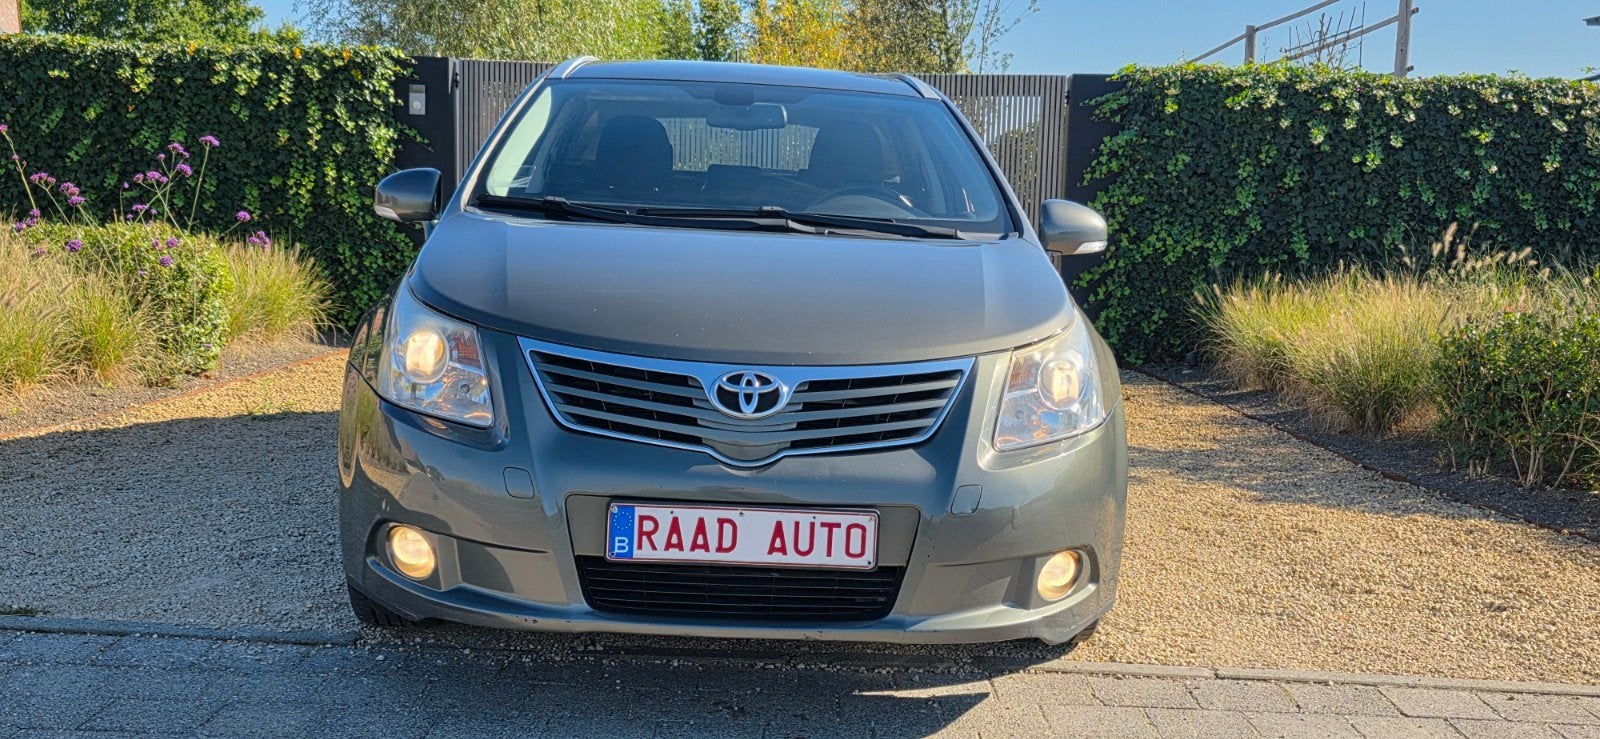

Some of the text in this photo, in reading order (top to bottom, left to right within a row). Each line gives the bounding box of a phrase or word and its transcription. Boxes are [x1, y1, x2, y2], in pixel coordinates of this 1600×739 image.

[614, 515, 867, 559] B RAAD AUTO
